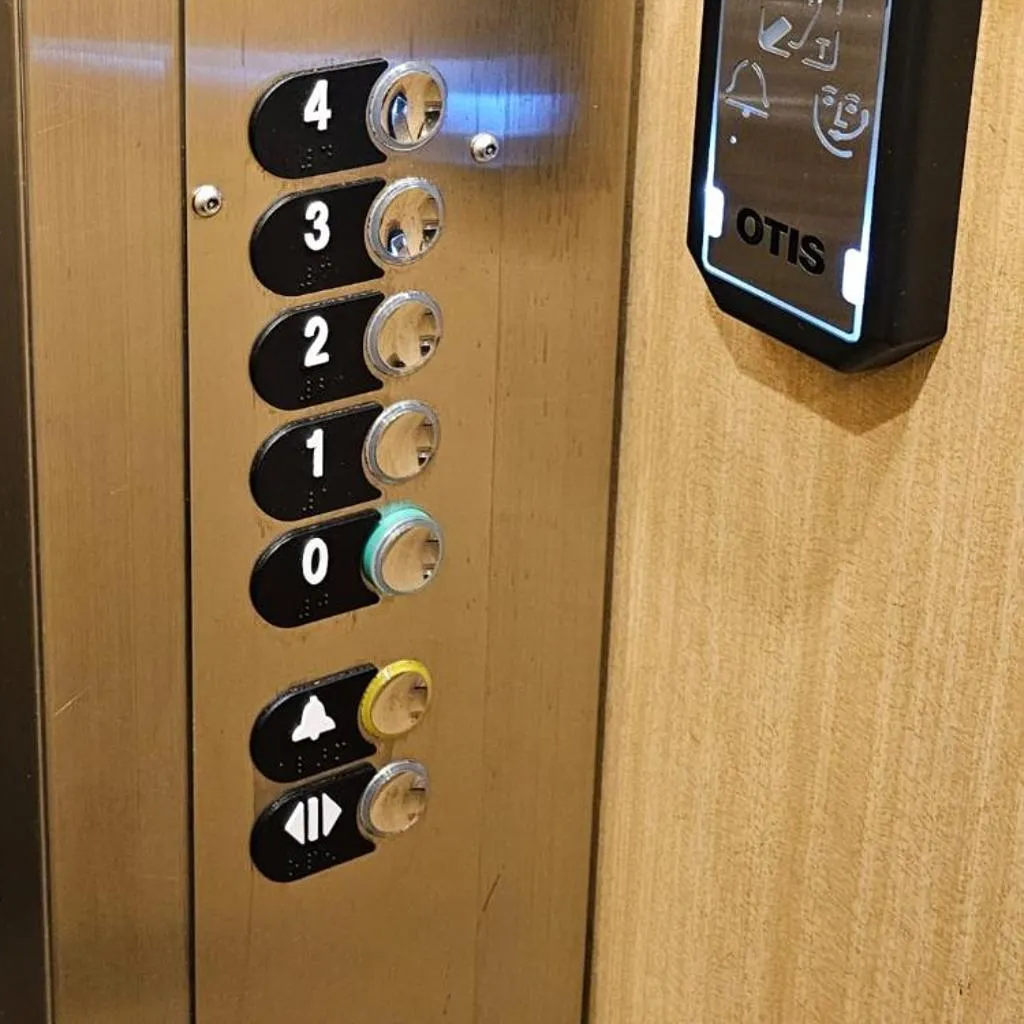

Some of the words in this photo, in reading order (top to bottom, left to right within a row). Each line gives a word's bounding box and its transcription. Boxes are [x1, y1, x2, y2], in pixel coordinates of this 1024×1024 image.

[303, 79, 332, 131] 4
[303, 199, 331, 252] 3
[736, 207, 826, 276] OTIS
[303, 315, 330, 367] 2
[306, 428, 325, 478] 1
[301, 537, 329, 586] 0
